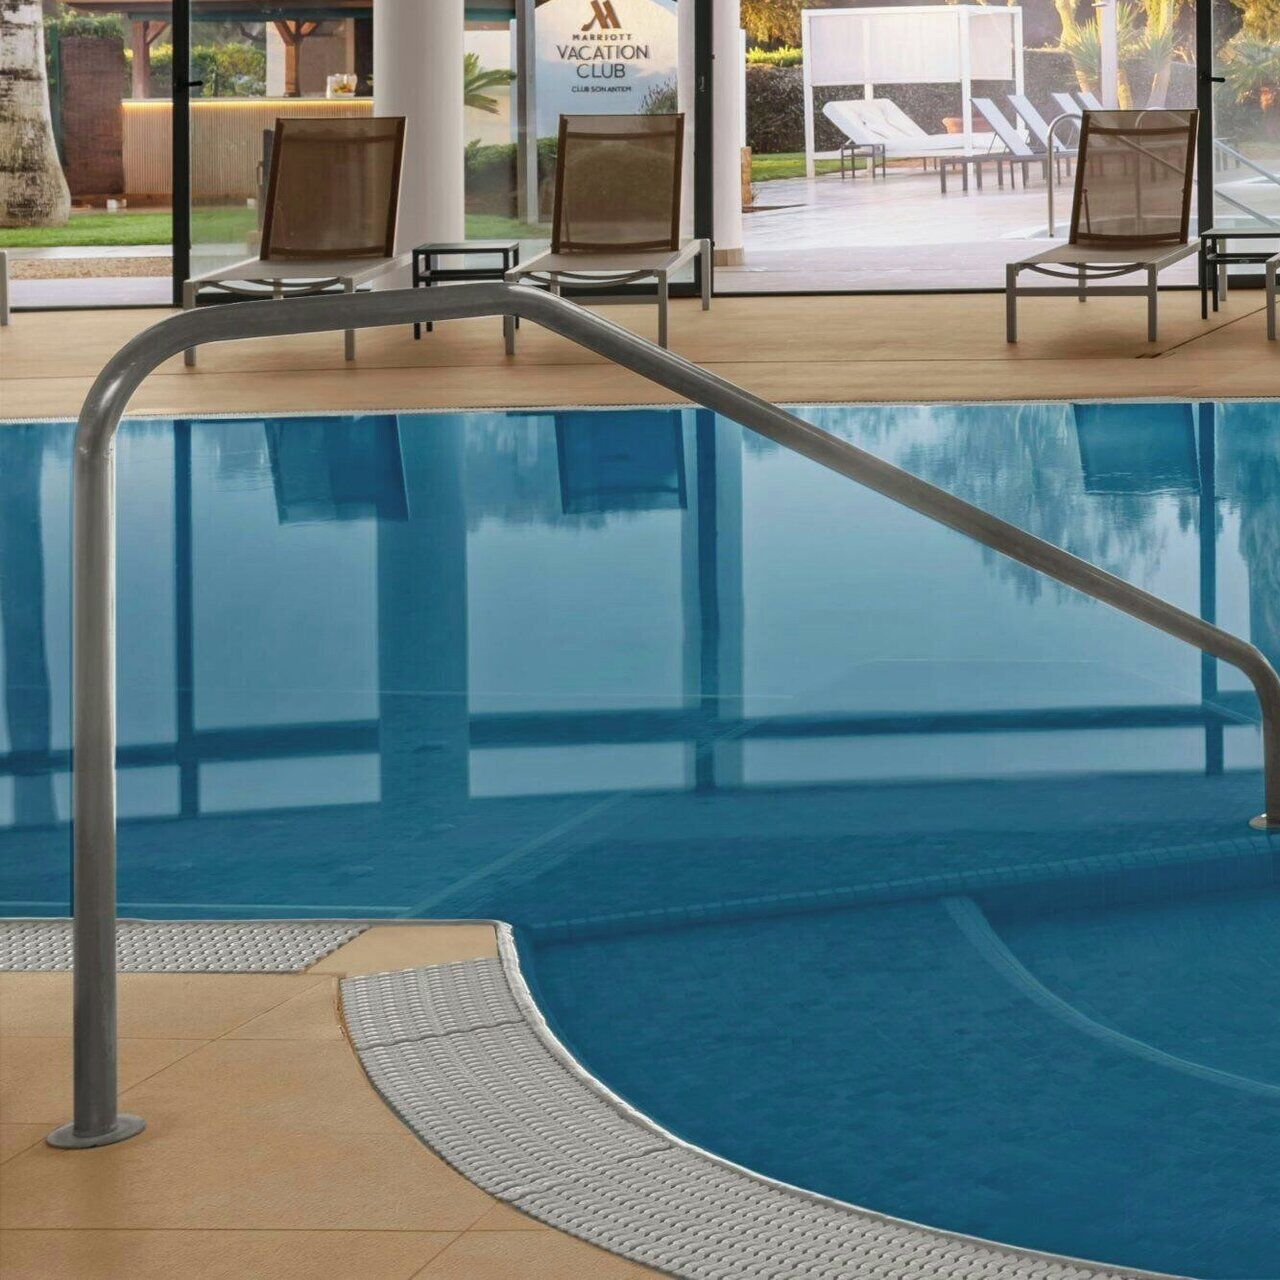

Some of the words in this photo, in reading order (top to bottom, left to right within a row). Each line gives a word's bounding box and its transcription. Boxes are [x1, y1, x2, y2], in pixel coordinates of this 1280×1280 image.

[572, 33, 632, 41] MARRIOTT
[556, 45, 649, 60] VACATION
[576, 63, 626, 79] CLUB
